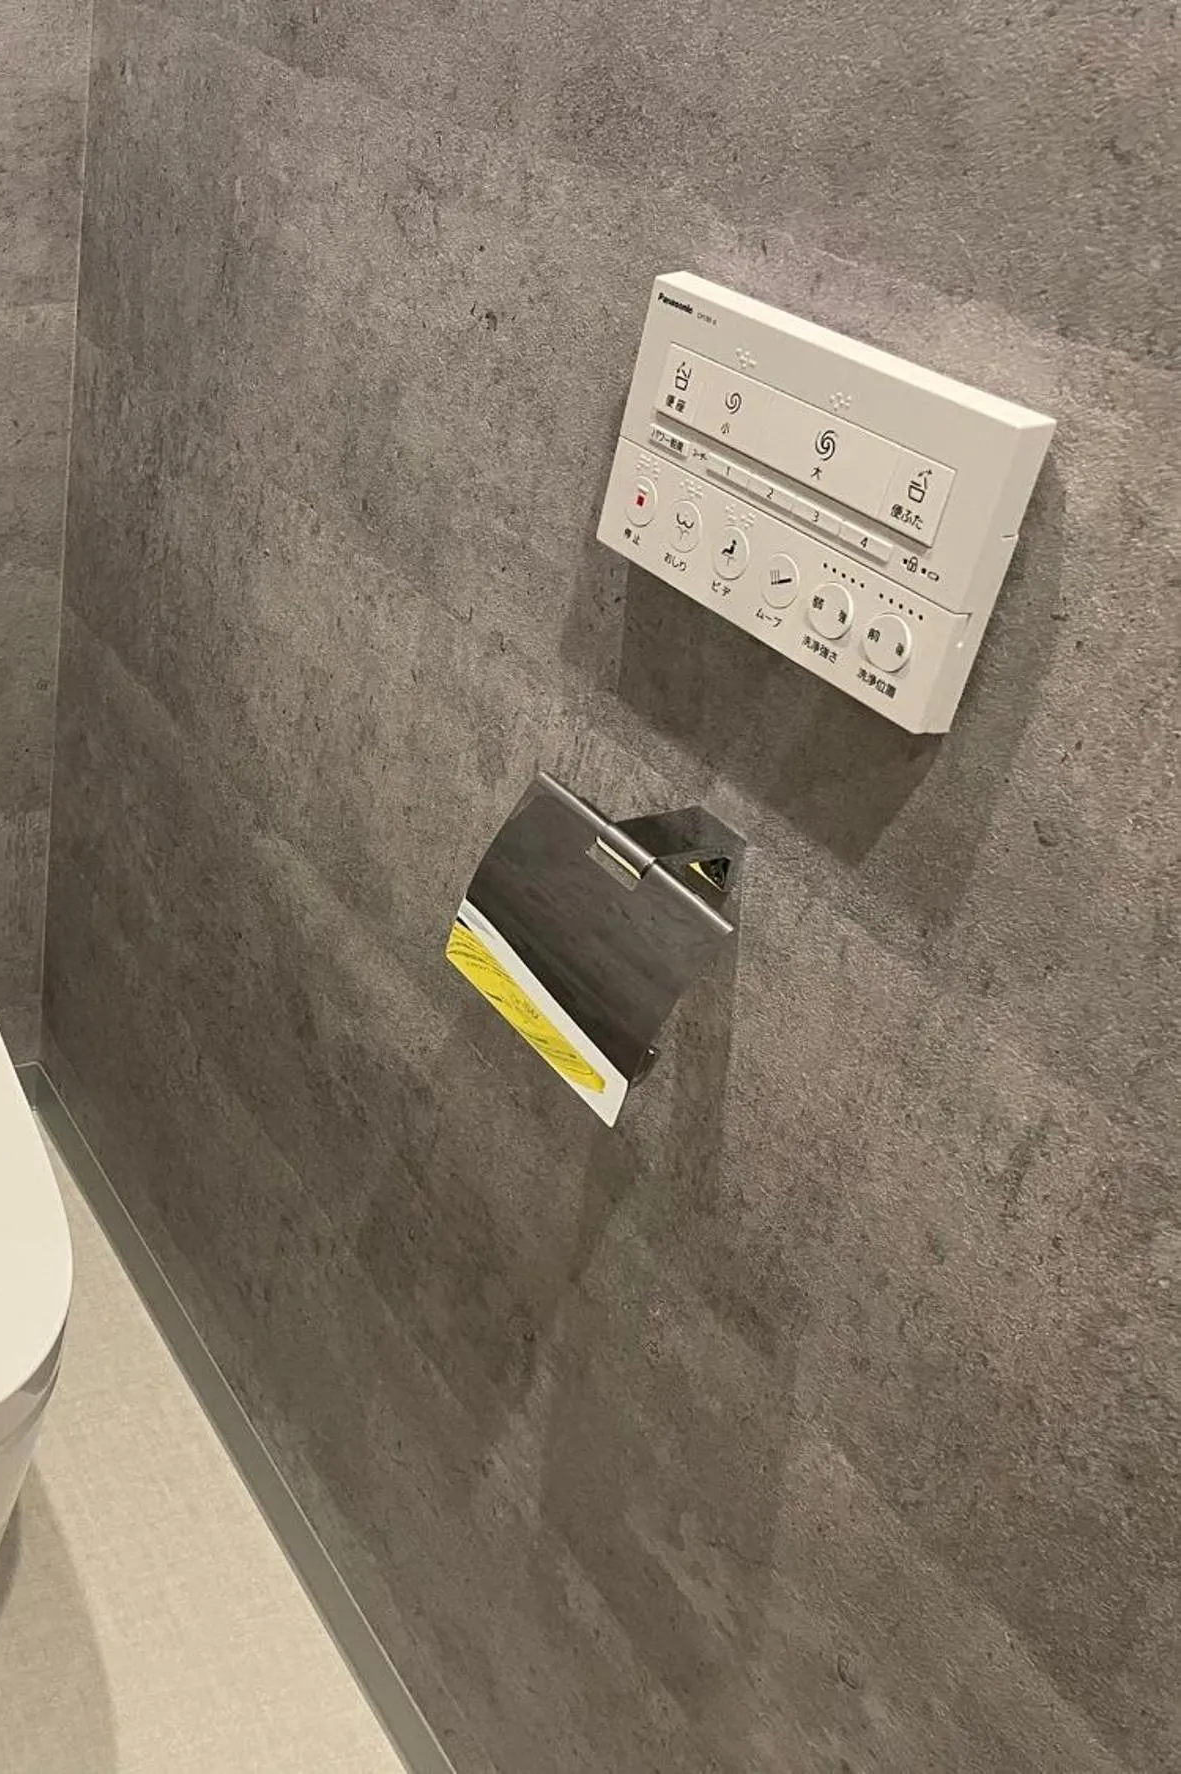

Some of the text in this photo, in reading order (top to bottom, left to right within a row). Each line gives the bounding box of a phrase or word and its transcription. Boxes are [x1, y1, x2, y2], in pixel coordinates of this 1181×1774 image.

[657, 292, 693, 315] Panasonic
[811, 466, 822, 480] 大
[890, 503, 923, 530] 便ふた
[664, 552, 687, 572] おしり
